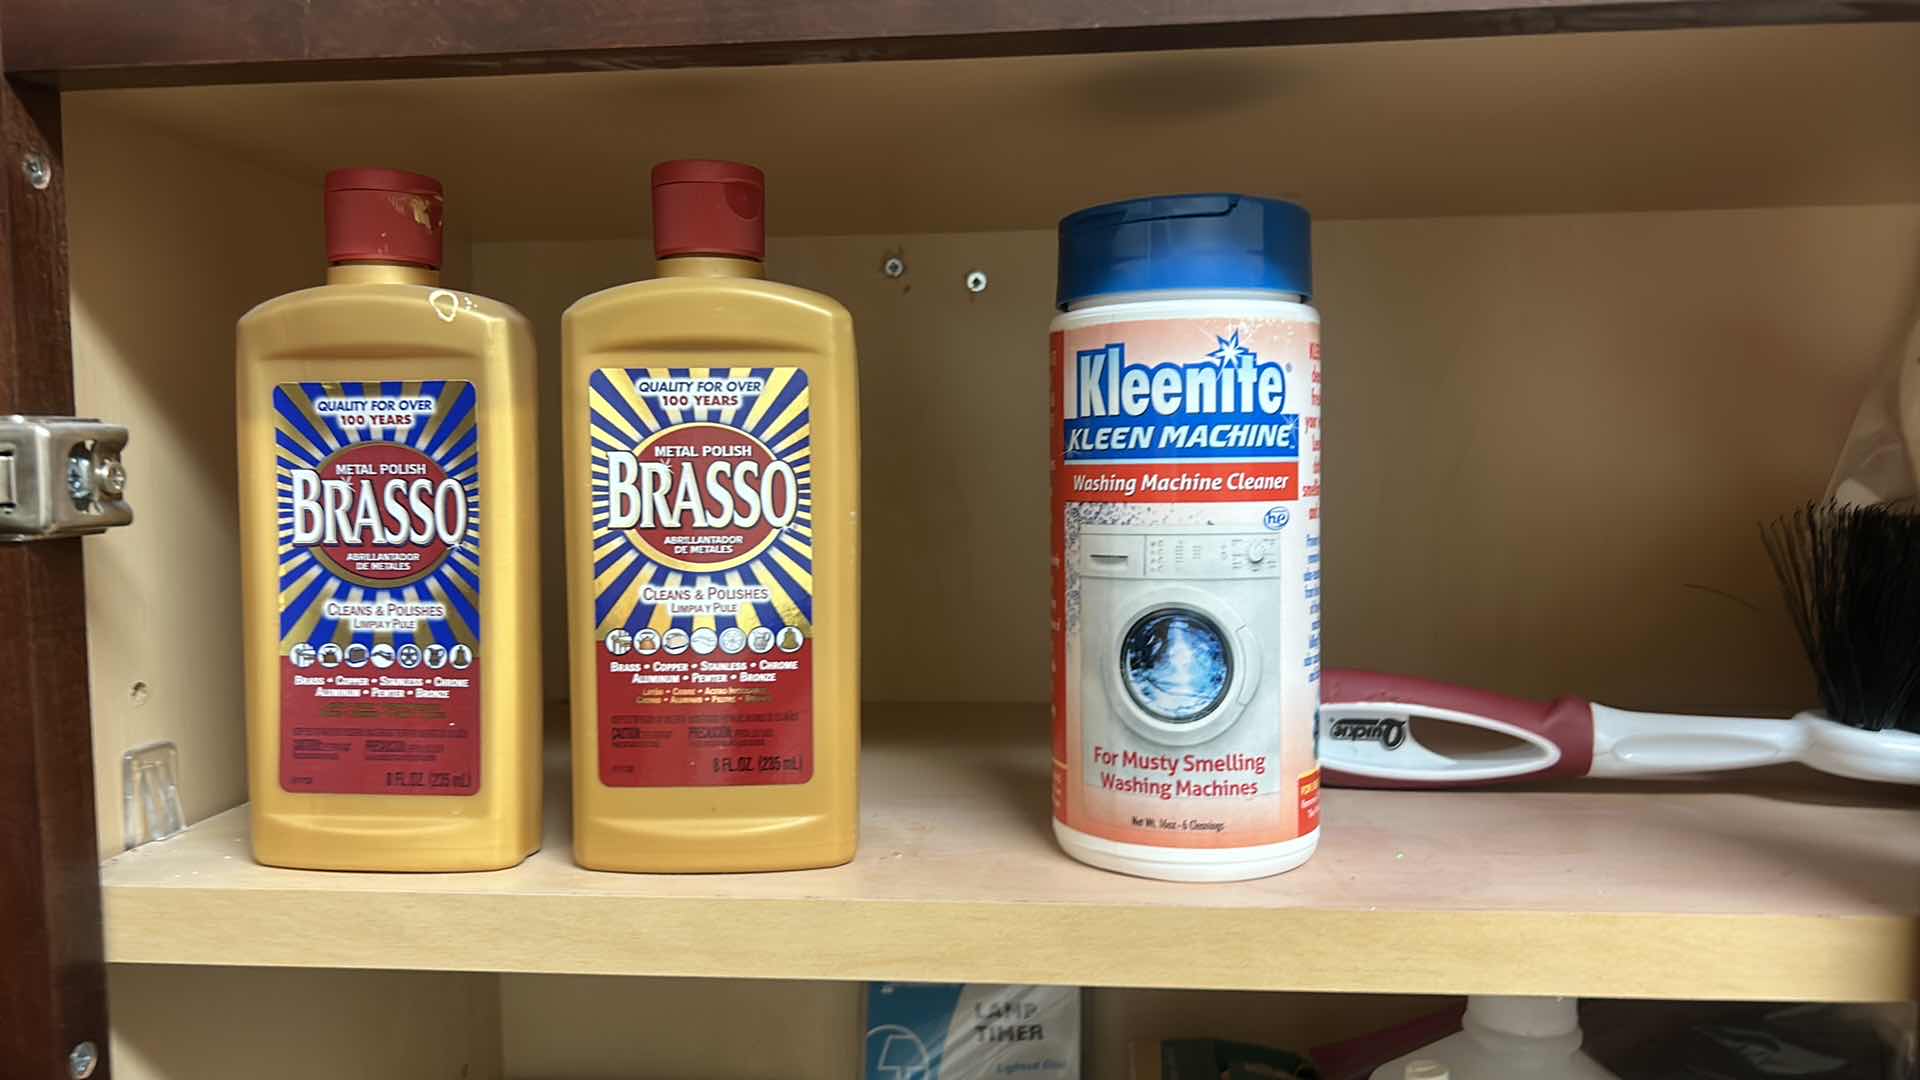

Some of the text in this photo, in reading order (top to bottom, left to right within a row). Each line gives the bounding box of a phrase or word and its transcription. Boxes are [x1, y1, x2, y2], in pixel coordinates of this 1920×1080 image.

[639, 381, 761, 392] QUALITY FOR OVER
[1078, 343, 1285, 417] Kleenite
[317, 399, 432, 413] QUALITY FOR OVER
[663, 395, 738, 406] 100 YEARS
[341, 415, 412, 426] 100 YEARS
[1067, 425, 1155, 452] KLEEN
[1158, 423, 1292, 448] MACHINE
[654, 445, 752, 457] METAL POLISH
[335, 463, 426, 475] METAL POLISH
[607, 450, 799, 530] BRASSO
[1073, 474, 1137, 495] Washing
[1141, 473, 1221, 492] Machine
[1226, 472, 1289, 490] Cleaner
[290, 468, 467, 547] BRASSO
[664, 535, 743, 545] ABRILLANTADOR
[674, 545, 733, 554] DE METALES
[356, 562, 369, 571] DE
[642, 586, 769, 601] CLEANS & POLISHES
[327, 602, 445, 617] CLEANS & POLISHES
[671, 602, 703, 613] LIMPIA
[713, 602, 737, 613] PULE
[610, 659, 799, 673] BRASS COPPER STAINLESS CHROME
[1331, 717, 1408, 752] Quickie
[713, 757, 720, 772] 8
[1094, 746, 1266, 776] For Musty Smelling
[1100, 772, 1259, 800] Washing Machines
[974, 1023, 1045, 1042] TIMER
